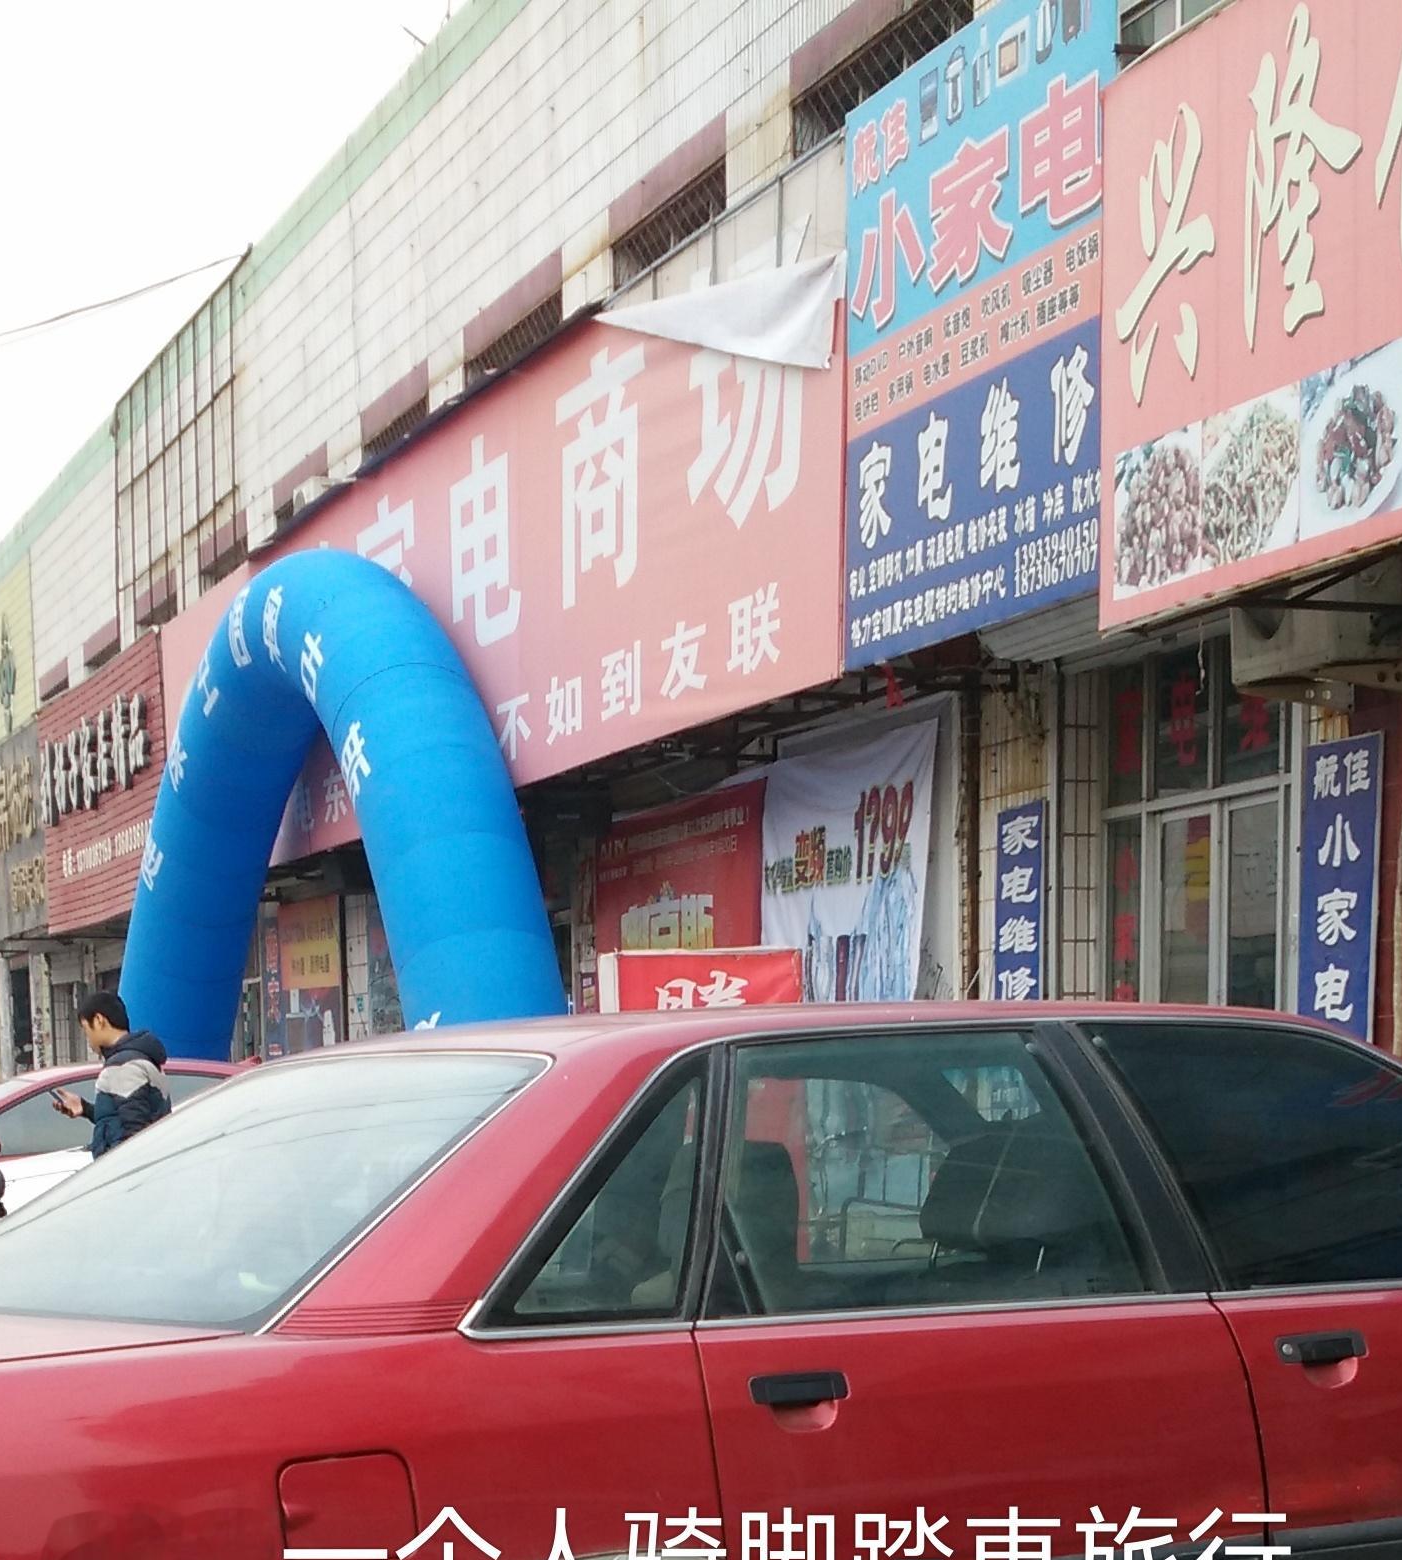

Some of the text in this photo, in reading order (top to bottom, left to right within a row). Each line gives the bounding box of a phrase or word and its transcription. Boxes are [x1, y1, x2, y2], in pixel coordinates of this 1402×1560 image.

[850, 73, 1103, 332] 小家电
[852, 100, 910, 197] 航佳
[981, 283, 1011, 318] 吹风机
[859, 344, 1095, 550] 家电维修
[1013, 517, 1099, 573] 13933940150
[1013, 544, 1099, 599] 18730670707
[495, 582, 782, 761] 不如到友联
[1313, 748, 1371, 801] 航佳
[998, 814, 1040, 1000] 家电维修
[1312, 812, 1362, 1023] 小家电
